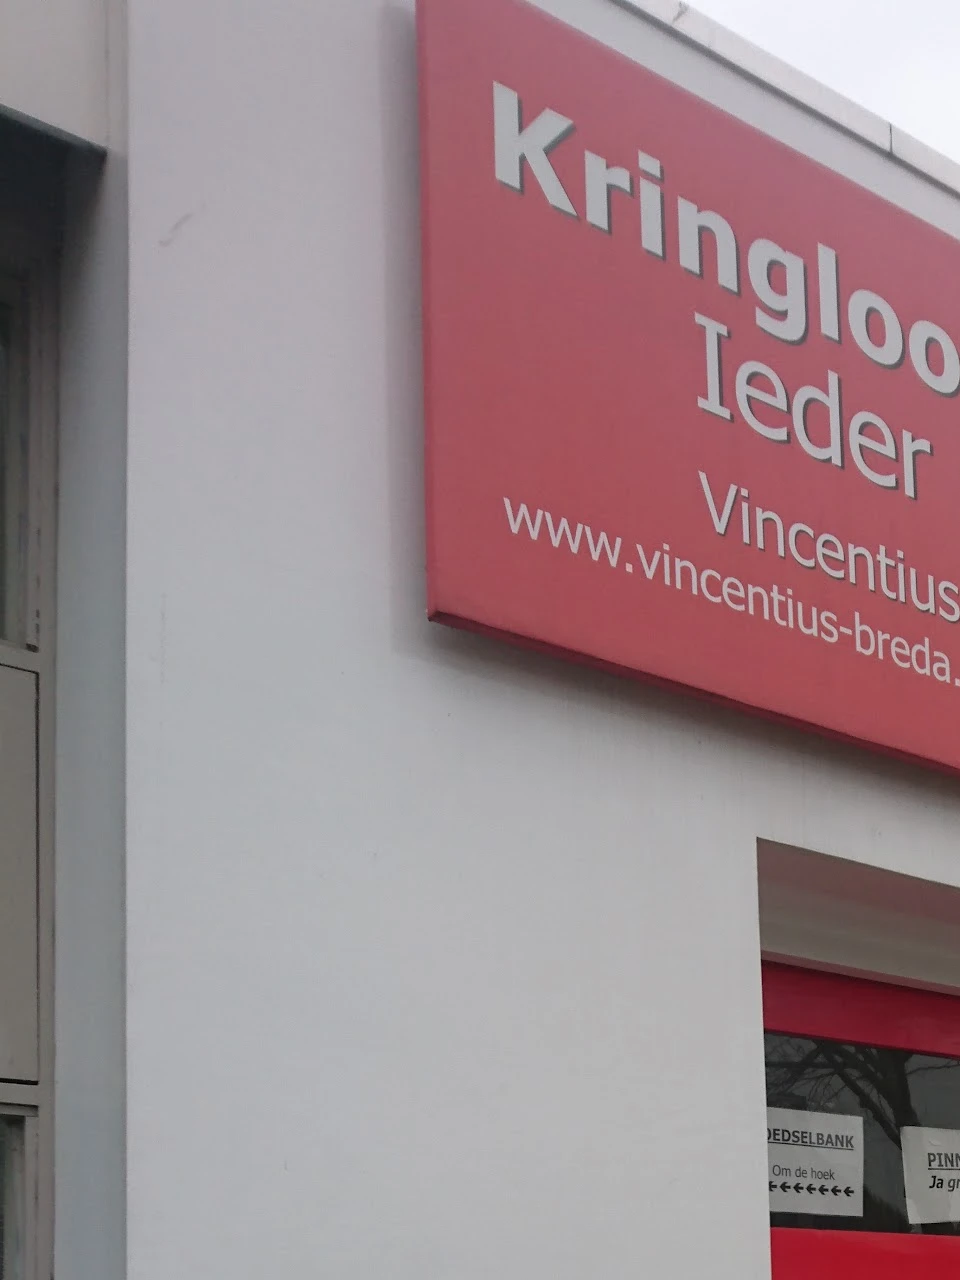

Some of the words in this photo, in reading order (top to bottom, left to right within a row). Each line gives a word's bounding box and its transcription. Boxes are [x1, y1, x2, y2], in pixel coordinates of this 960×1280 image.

[694, 311, 931, 499] Ieder
[698, 470, 960, 622] Vincentius
[772, 1164, 791, 1177] Om
[795, 1166, 808, 1178] de
[811, 1167, 836, 1181] hoek
[929, 1175, 944, 1189] Ja
